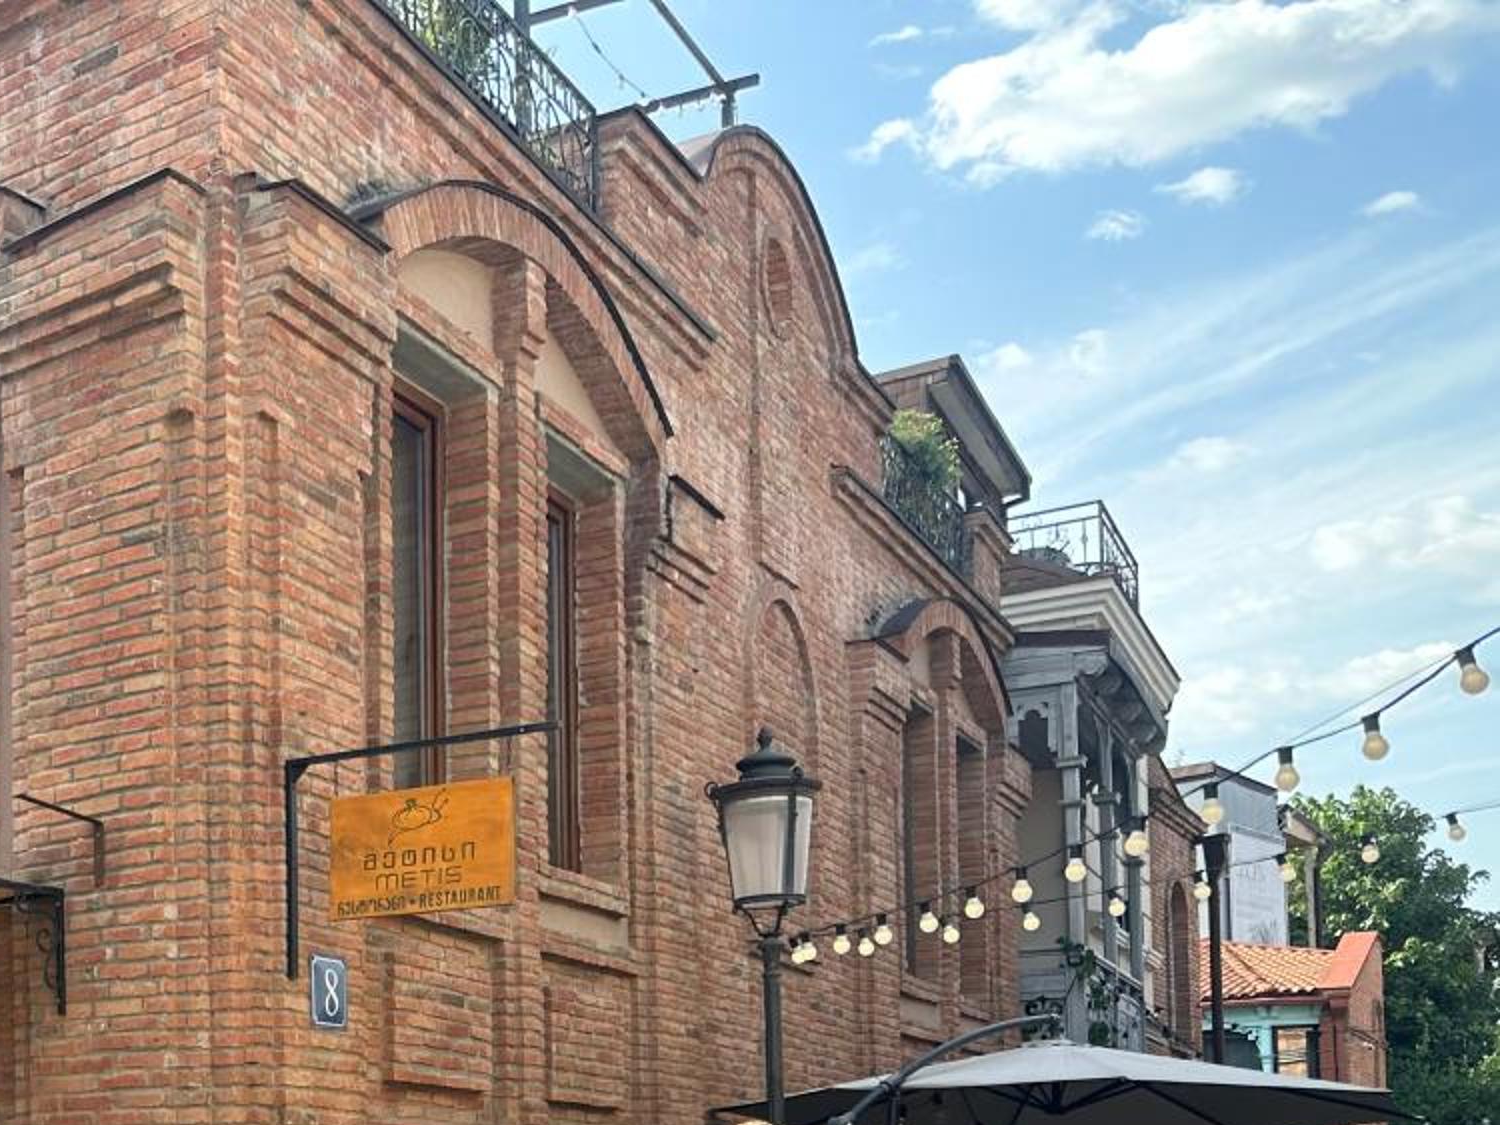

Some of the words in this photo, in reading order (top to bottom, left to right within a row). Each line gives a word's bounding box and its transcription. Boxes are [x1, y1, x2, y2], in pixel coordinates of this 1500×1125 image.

[375, 865, 463, 891] METIS
[419, 885, 502, 909] RESTAURANT
[325, 968, 339, 1017] 8
